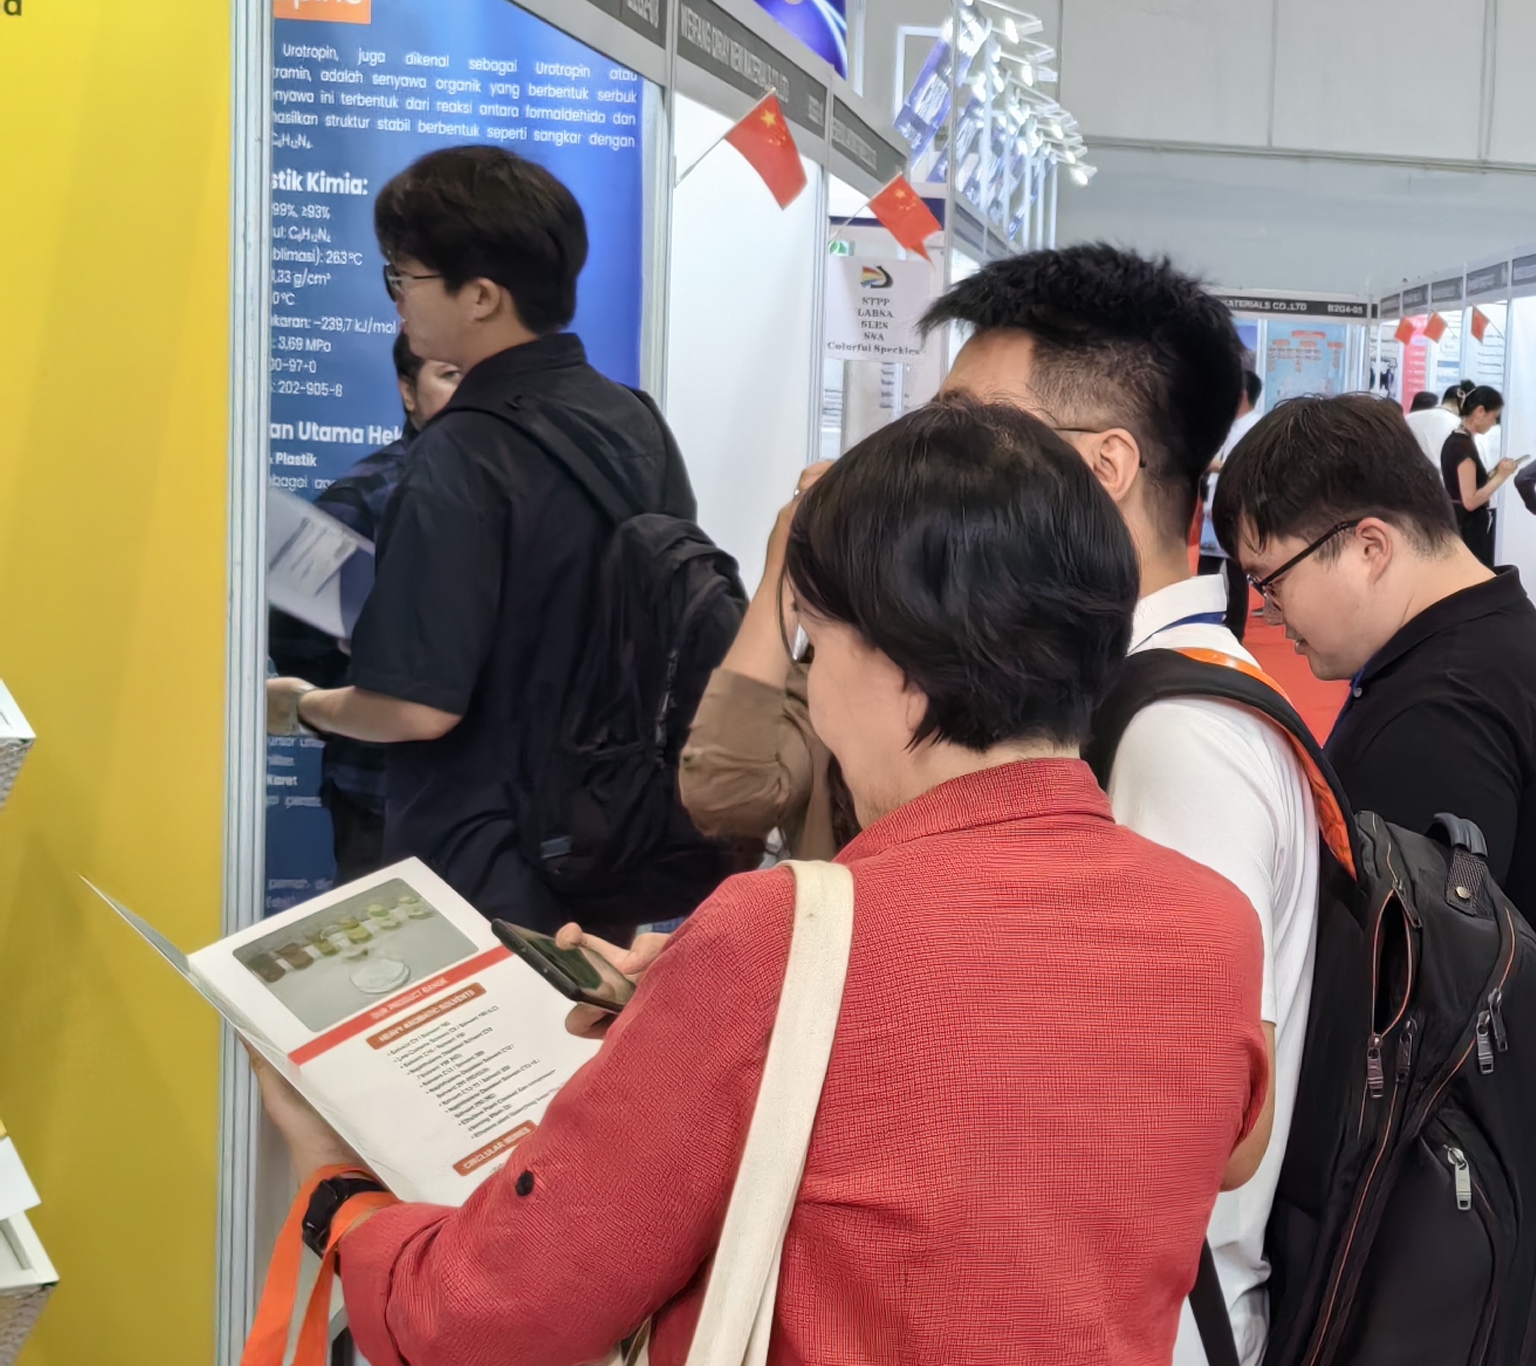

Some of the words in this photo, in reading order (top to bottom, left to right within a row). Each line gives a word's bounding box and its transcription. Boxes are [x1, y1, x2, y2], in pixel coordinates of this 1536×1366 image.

[357, 47, 386, 66] juga
[405, 51, 449, 67] dikenal
[469, 57, 518, 75] sebagai
[536, 61, 591, 80] Urotropin
[320, 69, 363, 83] adalah
[372, 76, 427, 90] senyawa
[436, 78, 482, 94] organik
[490, 83, 520, 99] yang
[528, 82, 589, 100] berbentuk
[597, 89, 637, 104] serbuk
[320, 90, 334, 104] ini
[341, 93, 399, 109] terbentuk
[406, 98, 430, 111] dari
[437, 100, 473, 114] reaksi
[479, 105, 519, 117] antara
[526, 106, 606, 123] formaldehida
[612, 112, 636, 125] dan
[325, 114, 370, 128] struktur
[377, 118, 411, 132] stabil
[418, 120, 480, 137] berbentuk
[487, 126, 527, 144] seperti
[534, 129, 582, 146] sangkar
[589, 133, 635, 150] dengan
[307, 170, 368, 195] Kimia:
[305, 339, 332, 353] MPa
[298, 421, 364, 444] Utama
[275, 452, 317, 467] Plastik
